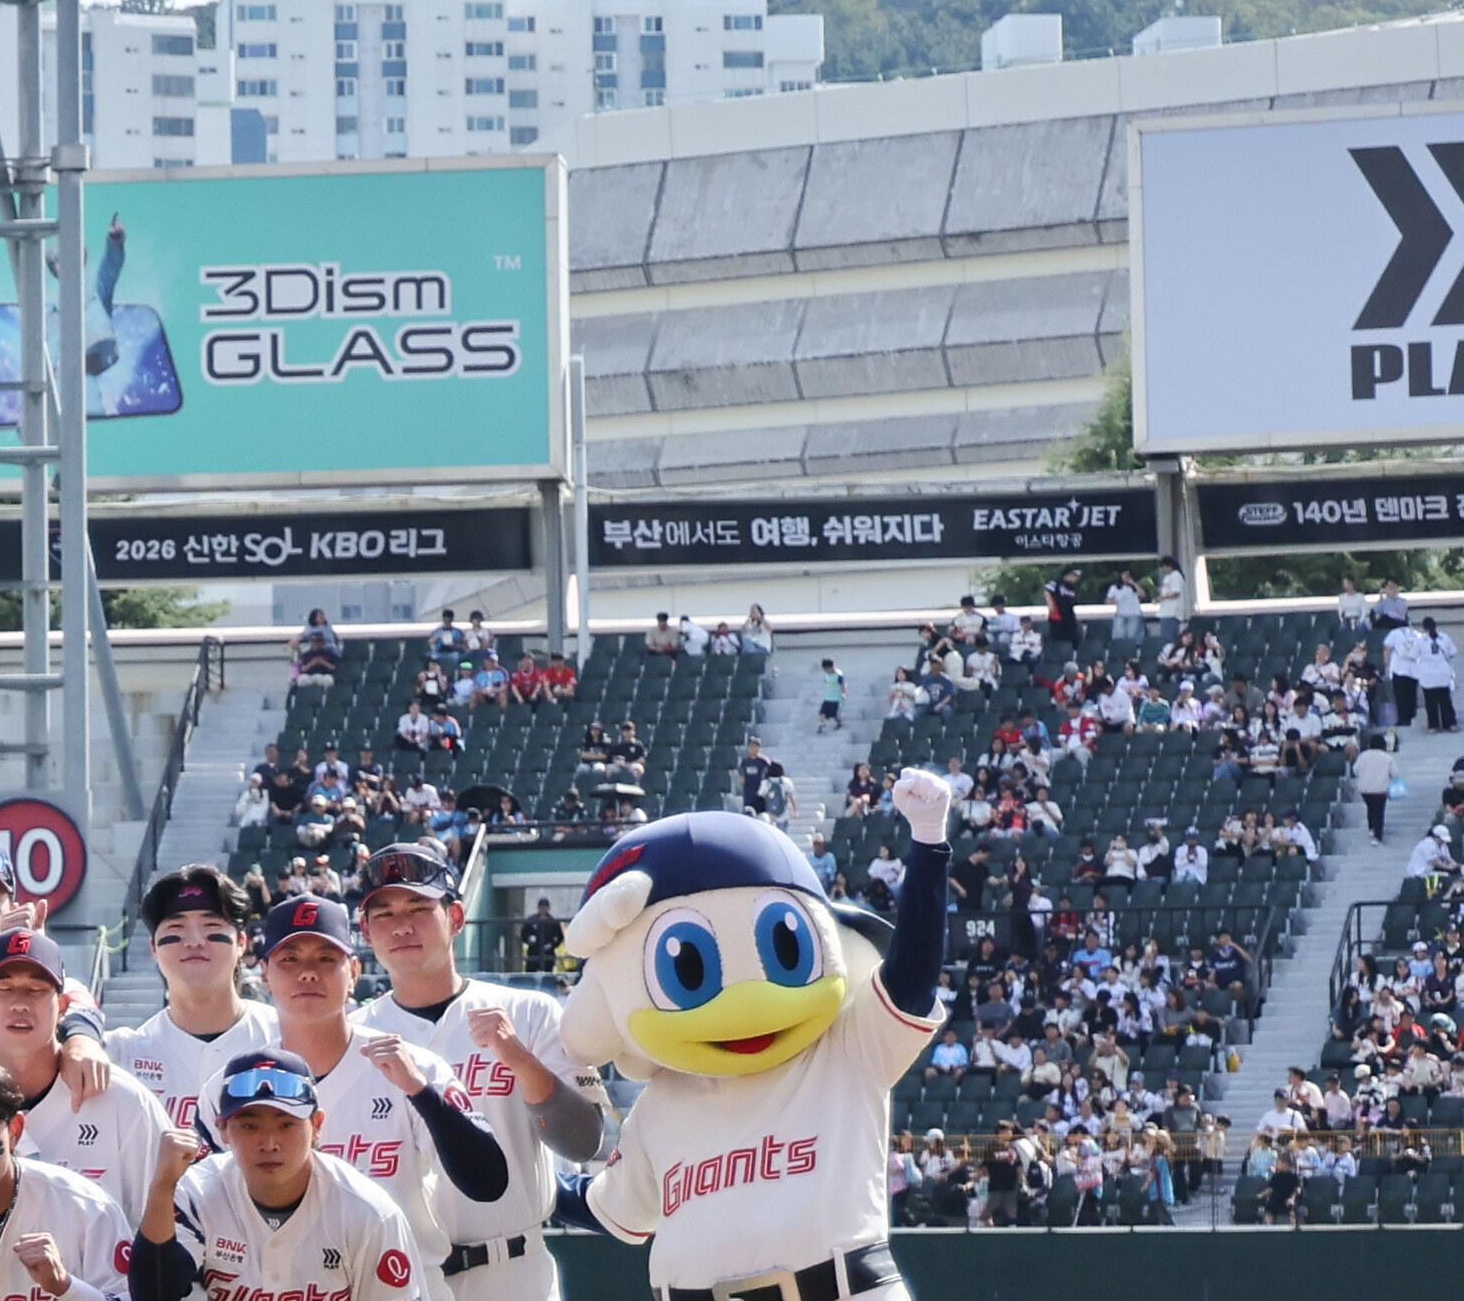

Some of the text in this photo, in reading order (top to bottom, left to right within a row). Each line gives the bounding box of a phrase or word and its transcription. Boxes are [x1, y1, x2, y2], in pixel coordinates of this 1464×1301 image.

[200, 261, 452, 323] 3Dism
[201, 319, 523, 386] GLASS
[973, 505, 1122, 531] EASTAR JET
[1293, 498, 1369, 524] 140년
[1375, 495, 1450, 524] 덴마크
[603, 513, 945, 549] 부산에서도 여행, 쉬워지다
[115, 539, 176, 562] 2026
[133, 1059, 164, 1072] BNK
[662, 1133, 820, 1218] Giants
[215, 1237, 247, 1254] BNK
